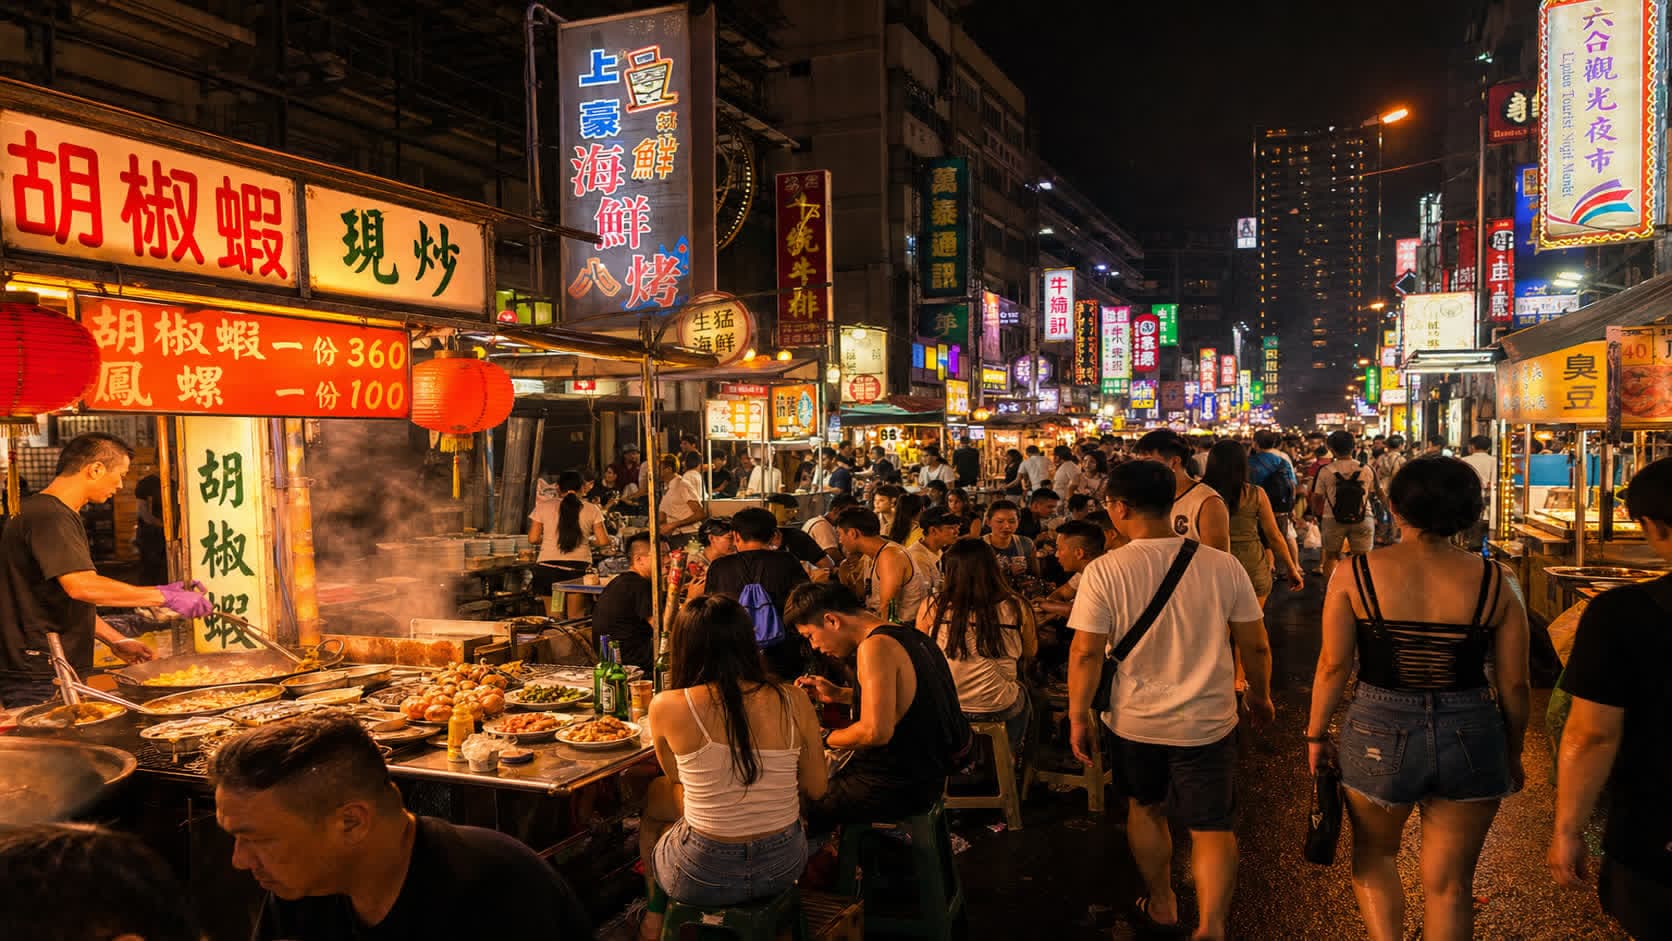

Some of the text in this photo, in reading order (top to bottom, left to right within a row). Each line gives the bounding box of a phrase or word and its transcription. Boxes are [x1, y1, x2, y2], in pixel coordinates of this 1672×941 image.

[1583, 7, 1618, 174] 六合觀光夜市
[7, 130, 288, 280] 胡椒蝦
[931, 167, 957, 289] 萬泰通訊
[341, 208, 460, 297] 現炒
[93, 308, 266, 361] 胡椒蝦
[347, 338, 405, 370] 360
[692, 308, 734, 332] 生猛
[692, 332, 736, 353] 海鮮
[1622, 343, 1648, 359] 40
[95, 361, 223, 409] 鳳螺
[351, 382, 404, 411] 100
[1563, 353, 1599, 411] 臭豆
[197, 449, 257, 649] 胡椒蝦
